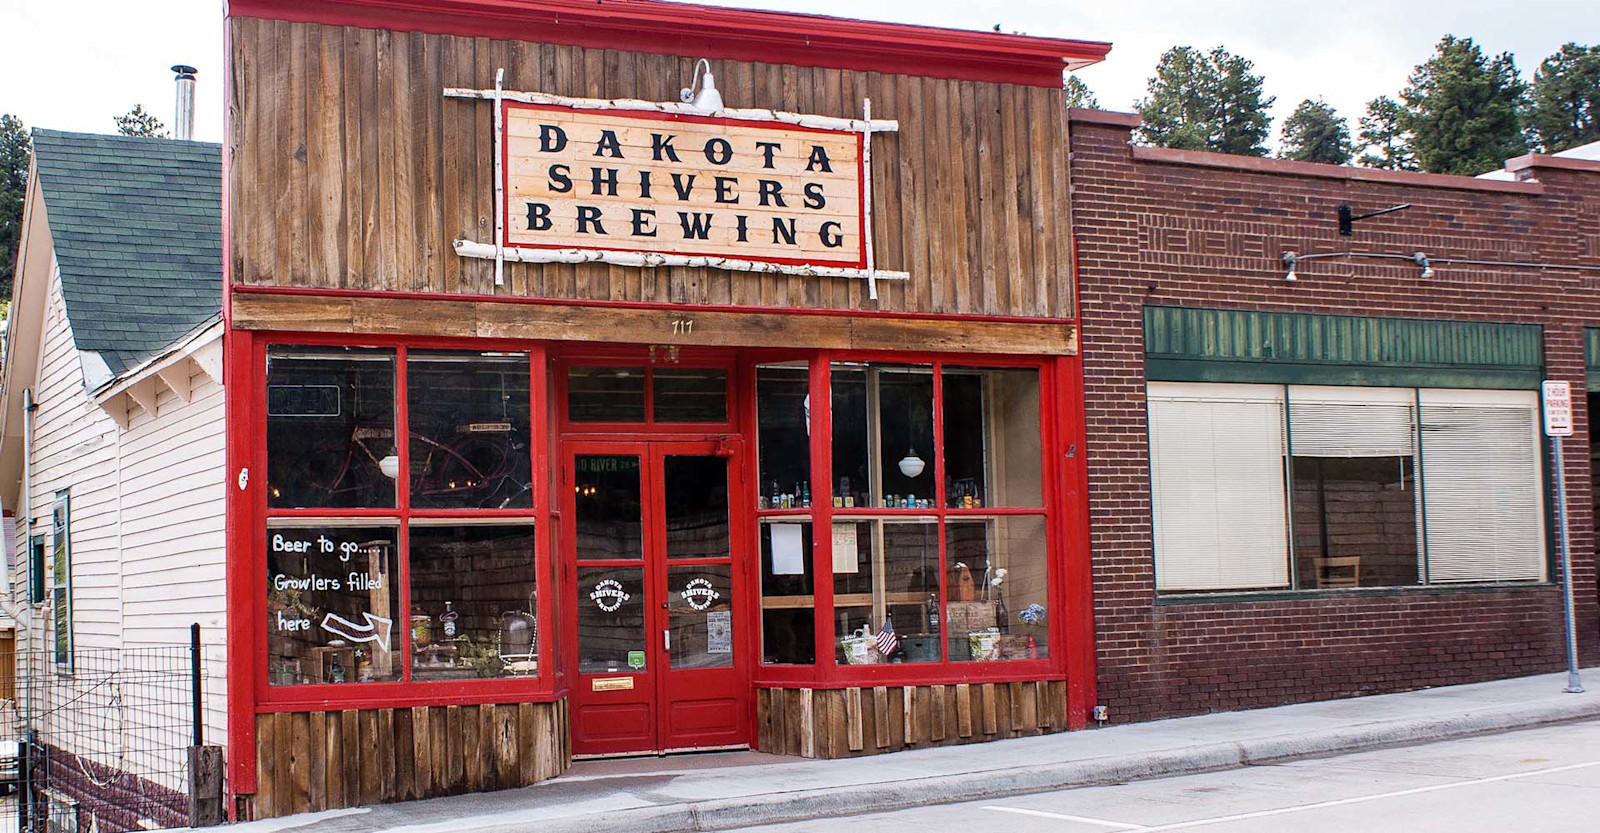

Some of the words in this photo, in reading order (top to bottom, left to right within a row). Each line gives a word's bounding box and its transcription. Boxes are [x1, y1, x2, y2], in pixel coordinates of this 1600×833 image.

[539, 124, 833, 173] DAKOTA
[547, 164, 826, 210] SHIVERS
[525, 202, 843, 248] BREWING
[671, 320, 694, 336] 717
[590, 458, 617, 472] RIVER
[272, 533, 312, 553] Beer
[317, 534, 334, 553] to
[274, 573, 341, 591] Growlers
[346, 572, 382, 591] filled
[595, 579, 623, 590] DAKOTA
[686, 578, 713, 589] DAKOTA
[589, 589, 631, 601] SHIVERS
[680, 588, 721, 600] SHIVERS
[595, 597, 623, 612] BREWING
[686, 596, 713, 610] BREWING
[277, 610, 311, 632] here
